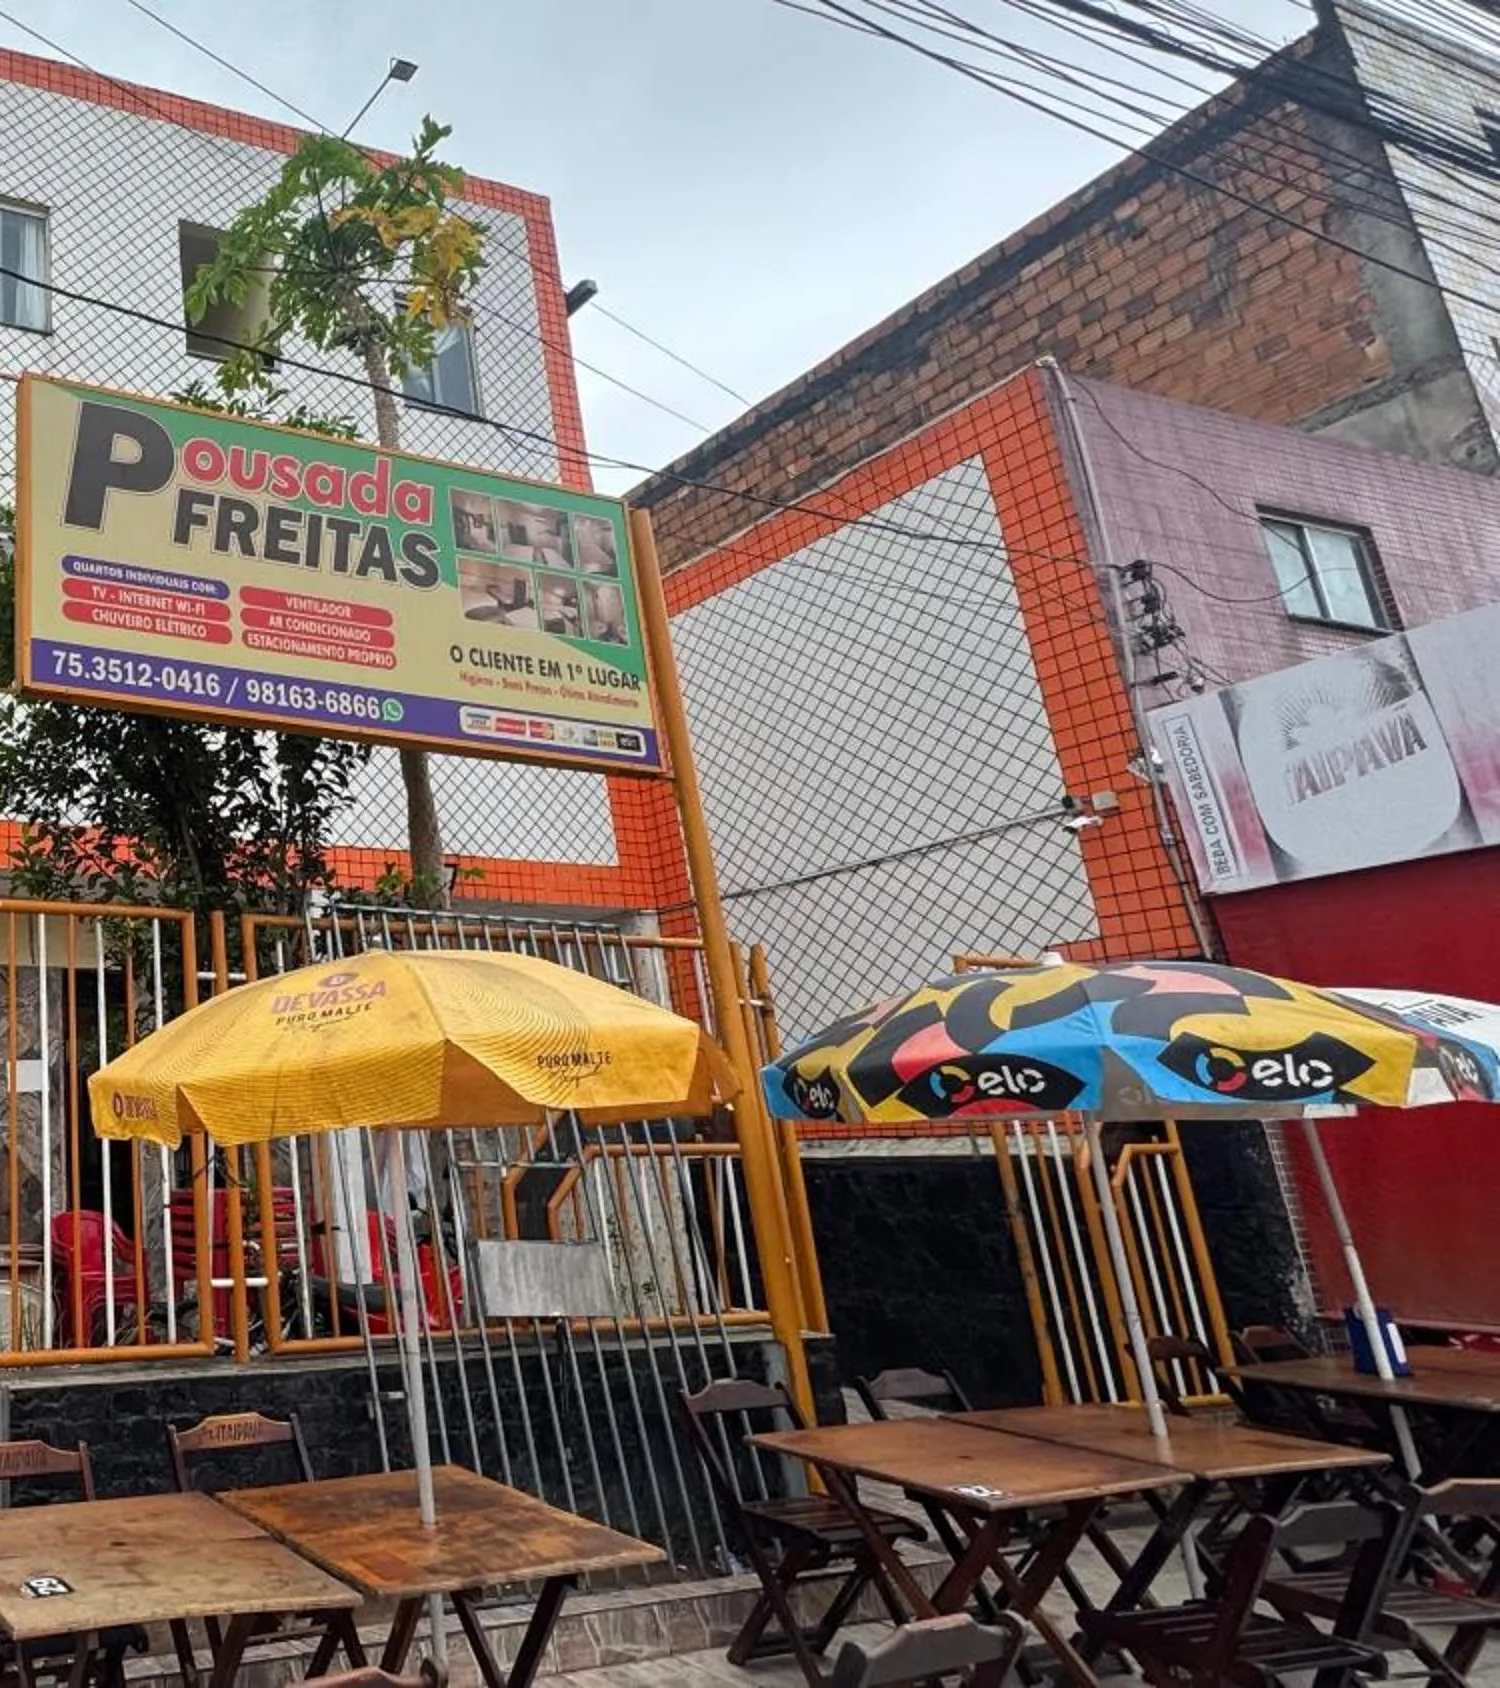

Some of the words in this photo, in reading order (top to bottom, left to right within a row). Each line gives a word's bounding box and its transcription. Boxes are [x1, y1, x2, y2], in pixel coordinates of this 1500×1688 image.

[64, 401, 434, 529] Pousada
[173, 488, 439, 587] FREITAS
[73, 561, 123, 578] QUARTOS
[92, 585, 106, 598] TV
[119, 591, 173, 610] INTERNET
[175, 600, 205, 615] WI-FI
[285, 597, 351, 618] VENTILADOR
[92, 609, 152, 629] CHUVEIRO
[269, 615, 284, 629] AR
[285, 618, 371, 642] CONDICIONADO
[248, 634, 345, 659] ESTACIONAMENTO
[450, 645, 463, 663] O
[469, 647, 534, 675] CLIENTE
[539, 659, 562, 679] EM
[587, 668, 641, 692] LUGAR
[52, 650, 220, 697] 75.3512-0416
[226, 677, 239, 704] /
[245, 679, 381, 719] 98163-6866
[1173, 725, 1208, 800] SABEDORIA
[1198, 804, 1219, 835] COM
[271, 981, 387, 1014] DEVASSA
[977, 1064, 1045, 1095] elo
[1252, 1053, 1334, 1088] elo
